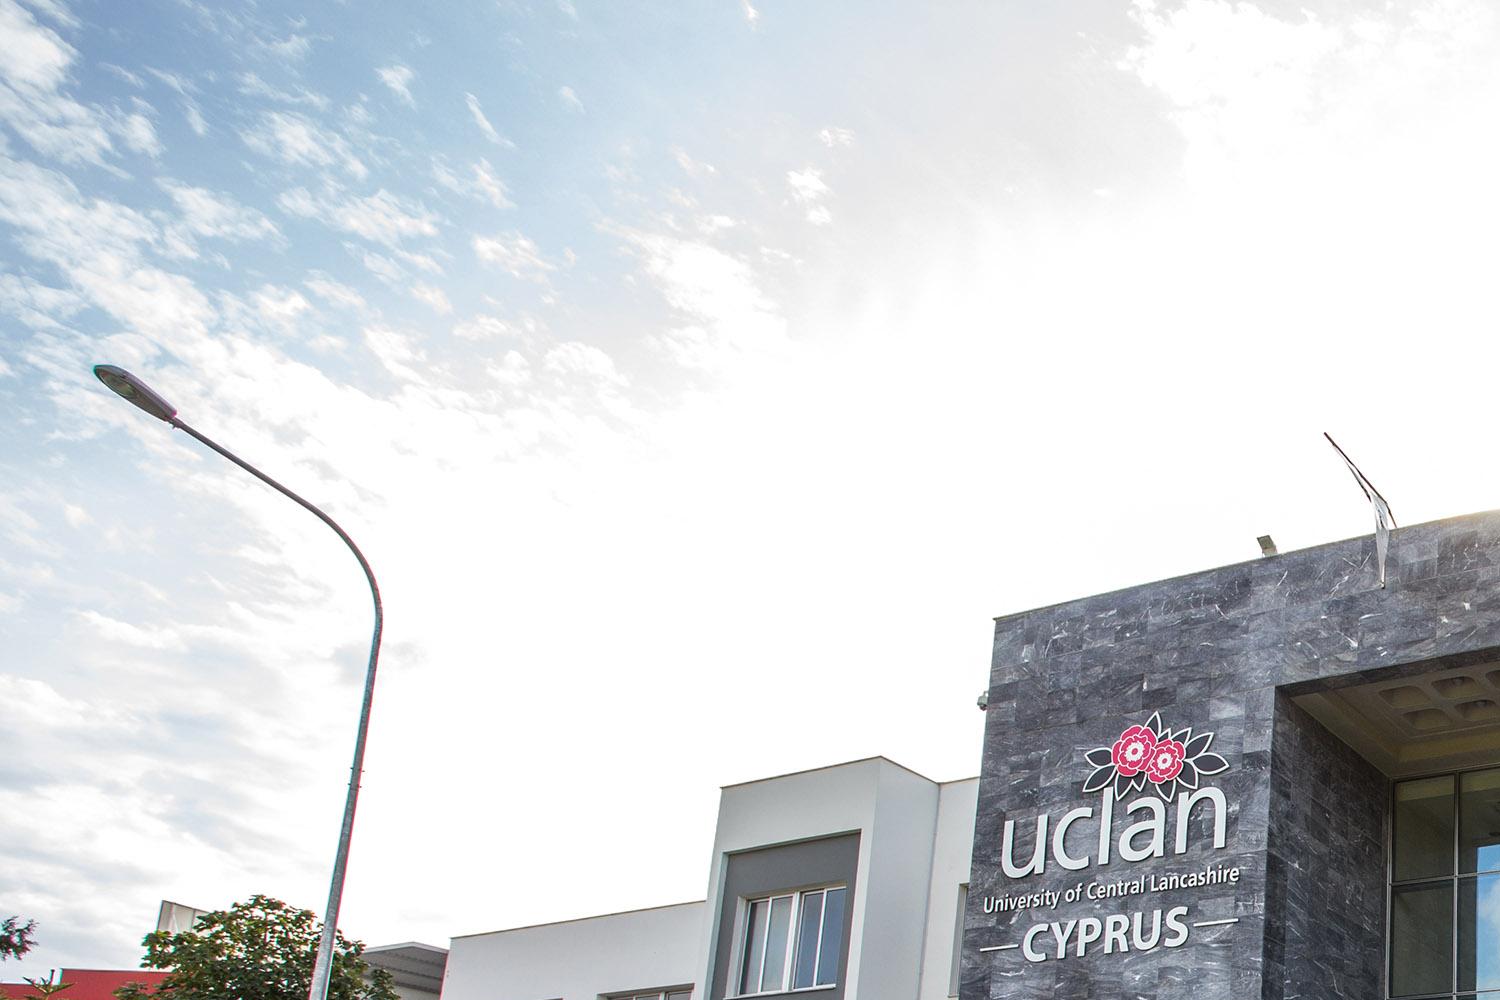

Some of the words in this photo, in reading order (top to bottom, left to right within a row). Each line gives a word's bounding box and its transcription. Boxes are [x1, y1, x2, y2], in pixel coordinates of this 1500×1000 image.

[1001, 786, 1227, 879] uclan
[983, 888, 1061, 913] University
[1065, 882, 1083, 903] of
[1086, 874, 1146, 900] Central
[1150, 864, 1240, 892] Lancashire
[1022, 906, 1190, 963] CYPRUS
